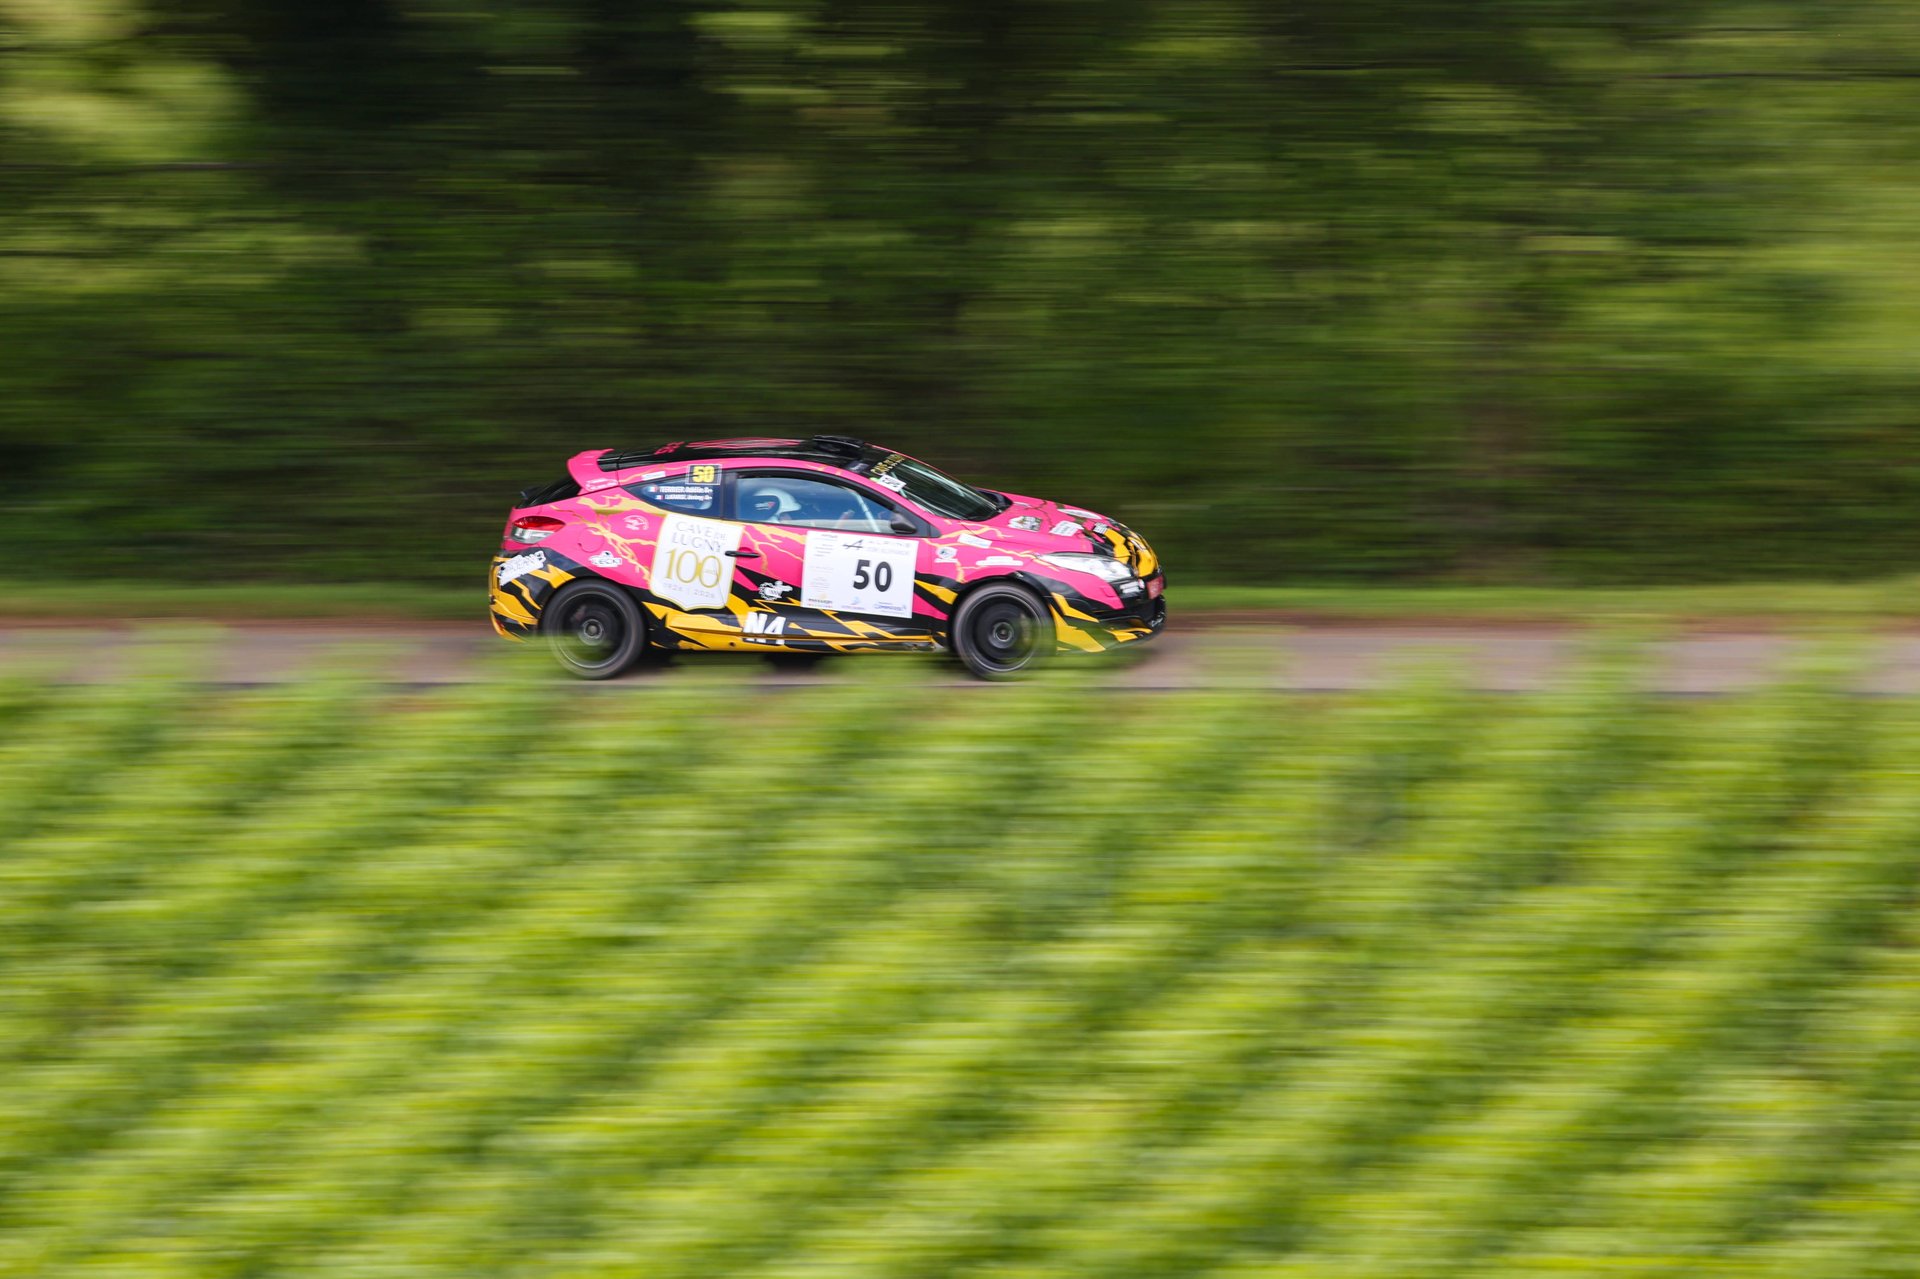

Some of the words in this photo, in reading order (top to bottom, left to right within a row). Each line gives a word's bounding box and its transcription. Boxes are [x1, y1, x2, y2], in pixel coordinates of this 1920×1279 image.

[692, 465, 715, 482] 50
[672, 532, 721, 552] LUGNY
[676, 521, 713, 537] CAVE
[664, 548, 723, 588] 100
[852, 559, 892, 593] 50
[743, 611, 786, 644] N4
